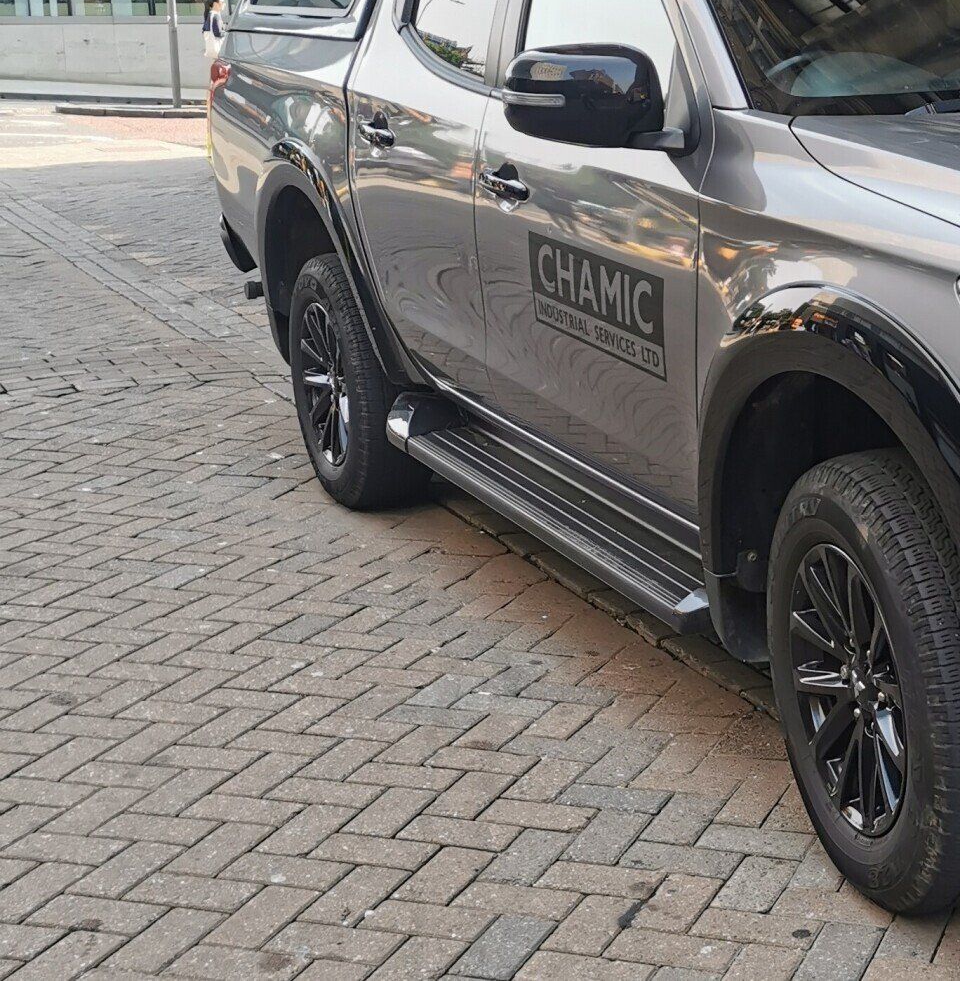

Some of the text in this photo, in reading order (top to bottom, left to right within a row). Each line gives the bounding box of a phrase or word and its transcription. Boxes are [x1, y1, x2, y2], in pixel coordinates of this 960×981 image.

[538, 244, 653, 334] CHAMIC
[538, 300, 660, 368] INDUSTRIAL SERVICES LTD
